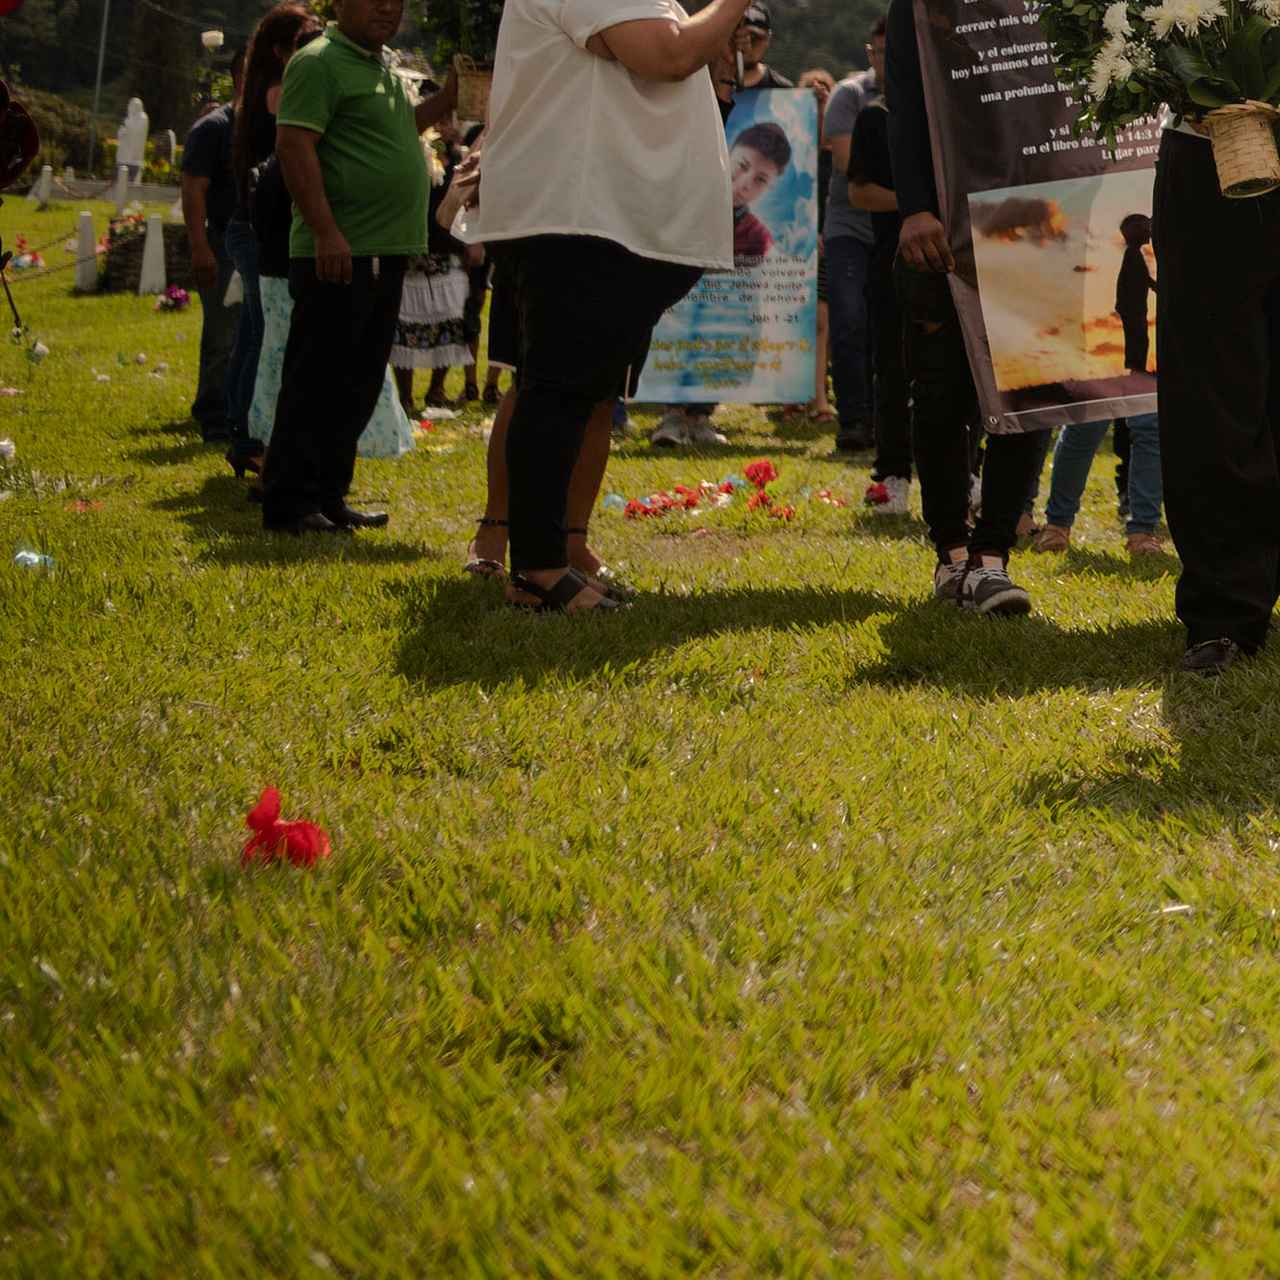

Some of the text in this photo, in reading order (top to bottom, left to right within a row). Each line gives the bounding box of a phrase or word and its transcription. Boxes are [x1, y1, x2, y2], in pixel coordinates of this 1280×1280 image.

[955, 18, 997, 34] cerraré
[999, 14, 1020, 27] mis
[977, 50, 985, 61] y
[987, 46, 999, 57] el
[1000, 41, 1048, 57] esfuerzo
[951, 68, 971, 80] hoy
[972, 64, 990, 76] las
[991, 59, 1030, 72] manos
[1031, 54, 1049, 66] del
[980, 91, 1002, 103] una
[1004, 82, 1055, 101] profunda
[1049, 128, 1057, 139] y
[1022, 145, 1037, 156] en
[1039, 142, 1050, 153] el
[1052, 138, 1079, 152] libro
[1081, 135, 1096, 148] de
